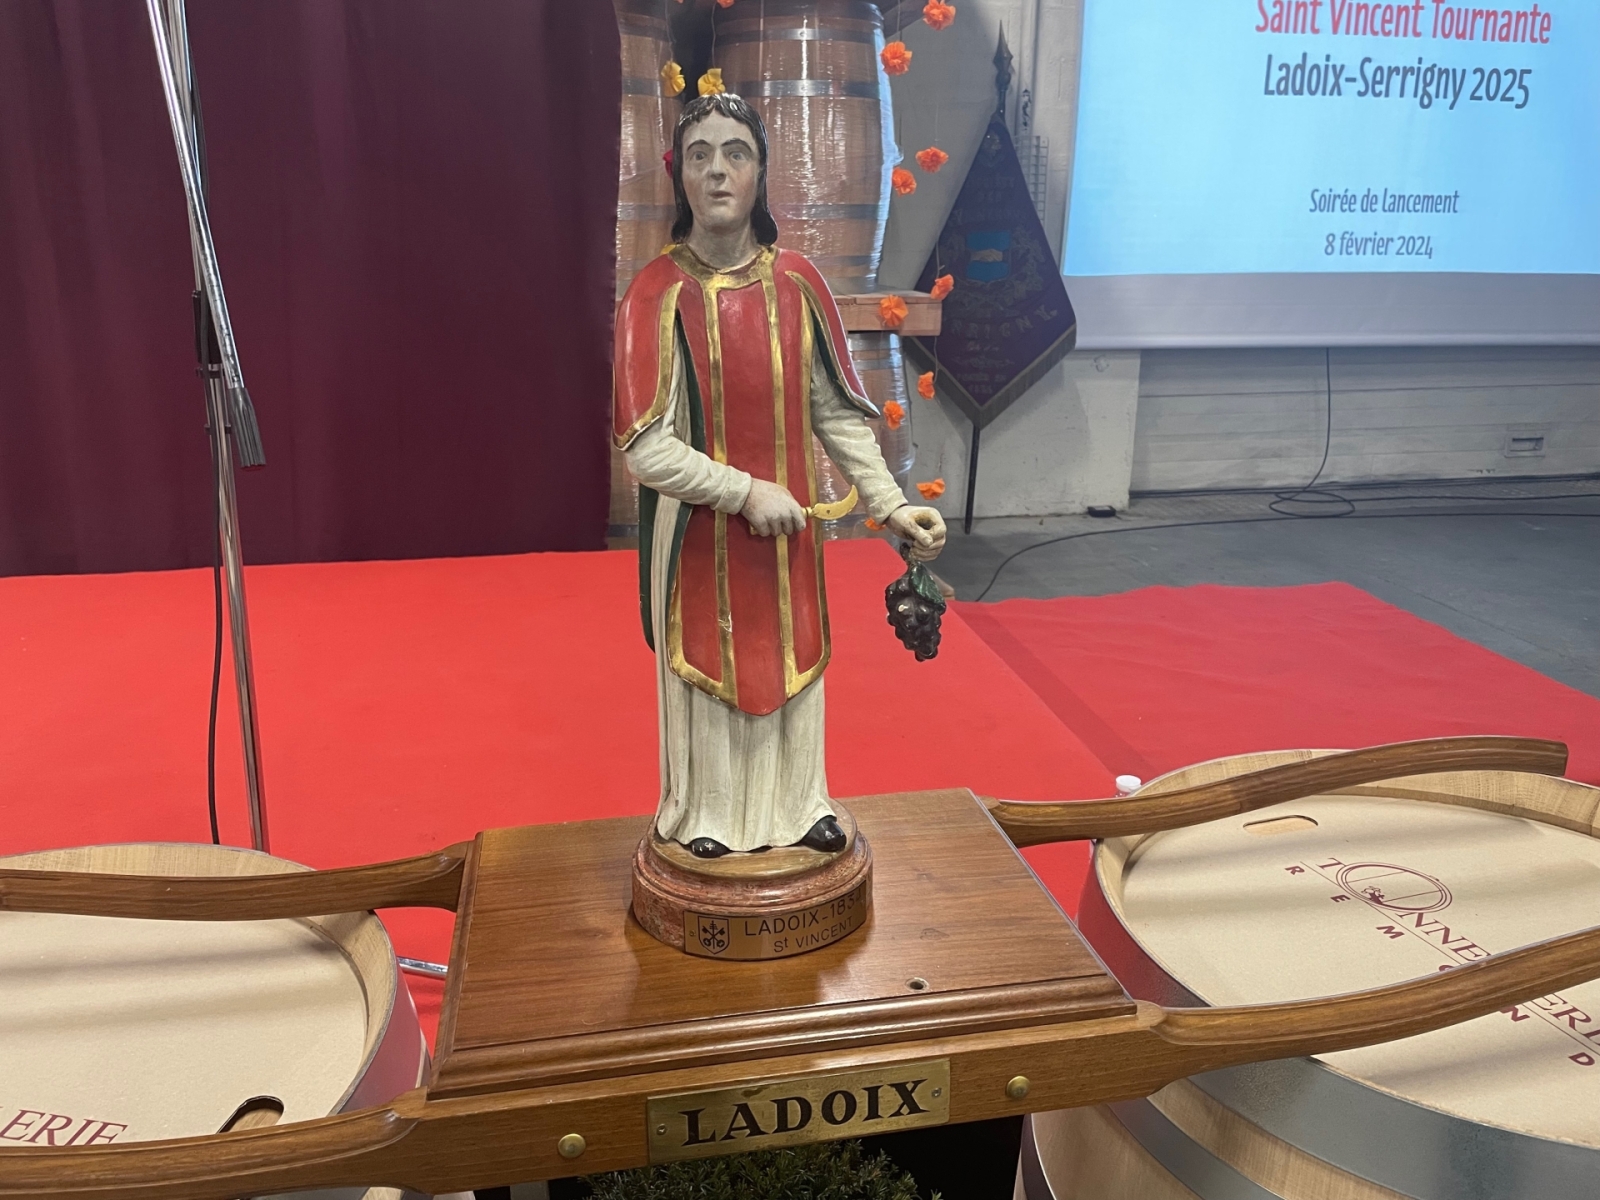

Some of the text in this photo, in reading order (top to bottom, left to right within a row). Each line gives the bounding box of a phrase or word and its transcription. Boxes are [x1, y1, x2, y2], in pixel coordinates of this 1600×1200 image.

[1255, 0, 1552, 44] Saint Vincent Tournante
[1264, 51, 1533, 110] Ladoix-Serrigny 2025
[1308, 188, 1358, 213] Soirée
[1360, 187, 1379, 213] de
[1324, 231, 1433, 259] 8 février 2024
[773, 915, 853, 953] St VINCENT
[678, 1078, 931, 1147] LADOIX
